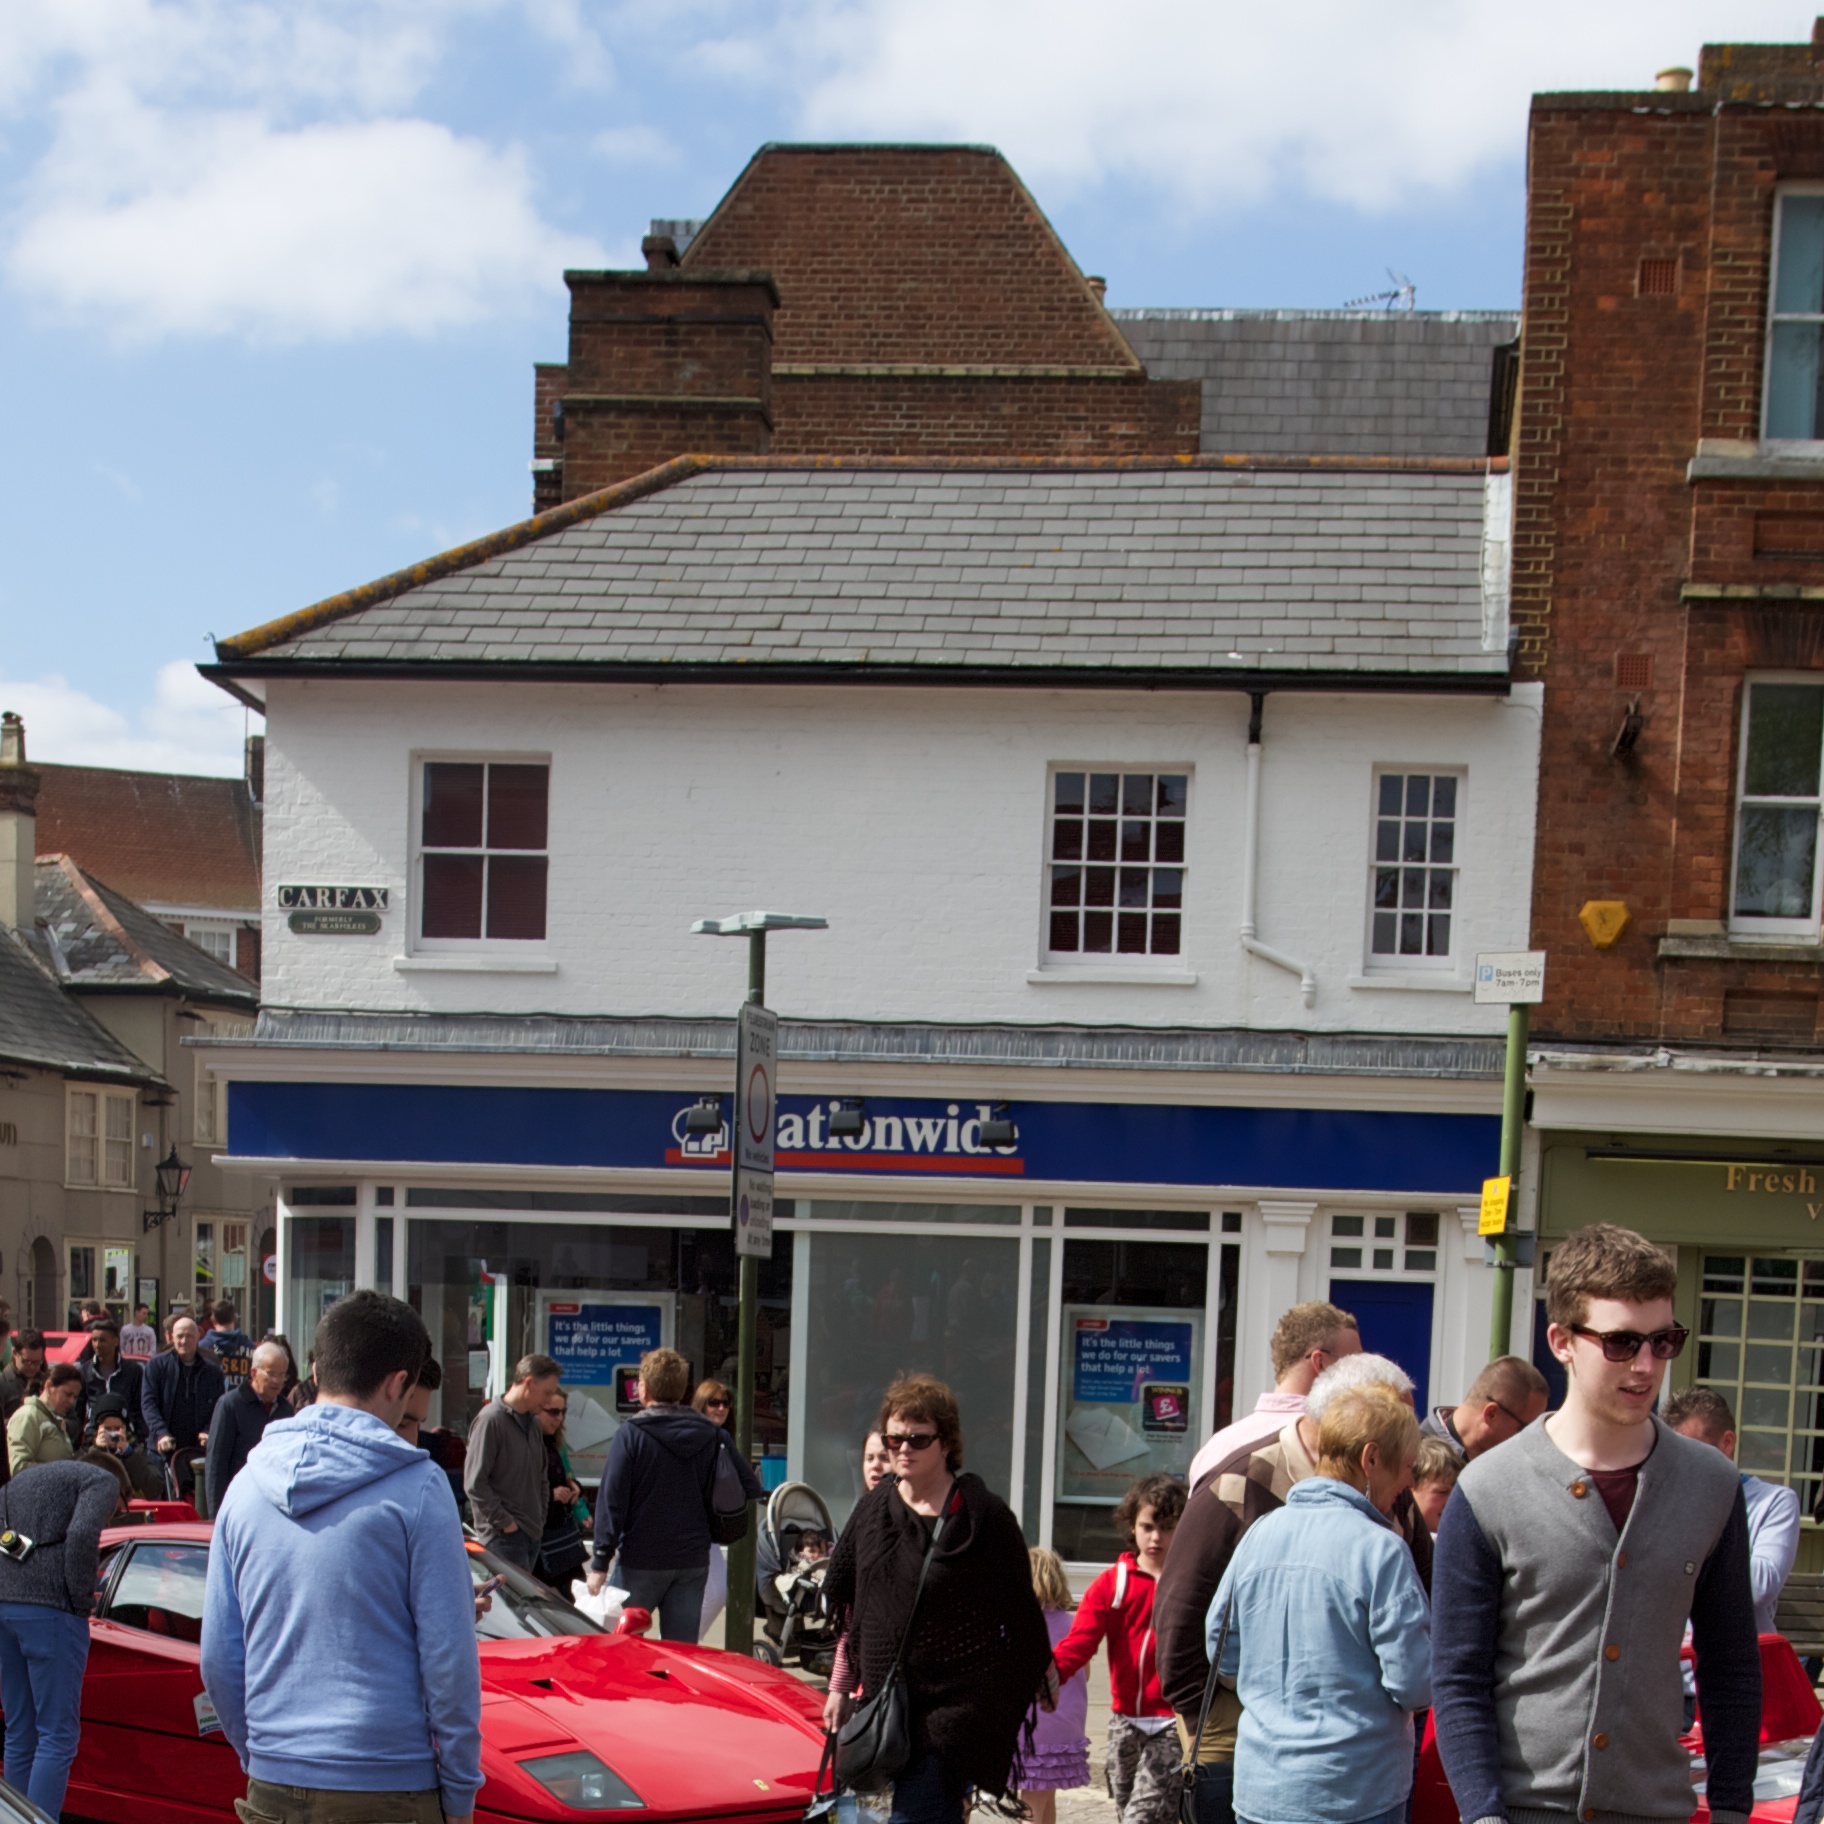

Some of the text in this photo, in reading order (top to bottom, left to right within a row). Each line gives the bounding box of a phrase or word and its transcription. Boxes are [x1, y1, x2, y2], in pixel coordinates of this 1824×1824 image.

[279, 887, 386, 908] CARFAX
[1496, 968, 1522, 977] Buses
[1525, 969, 1541, 979] only
[750, 1032, 770, 1057] ZONE
[1726, 1165, 1816, 1194] Fresh
[555, 1321, 645, 1334] It's the little things
[555, 1335, 569, 1343] we
[586, 1334, 600, 1344] for
[602, 1336, 618, 1344] our
[621, 1337, 651, 1345] savers
[1082, 1337, 1175, 1350] It's the little things
[555, 1346, 574, 1355] that
[577, 1346, 597, 1358] help
[608, 1347, 621, 1357] lot
[1081, 1351, 1181, 1363] we do for our savers
[1081, 1362, 1101, 1372] that
[1104, 1362, 1125, 1374] help
[1136, 1364, 1150, 1374] lot
